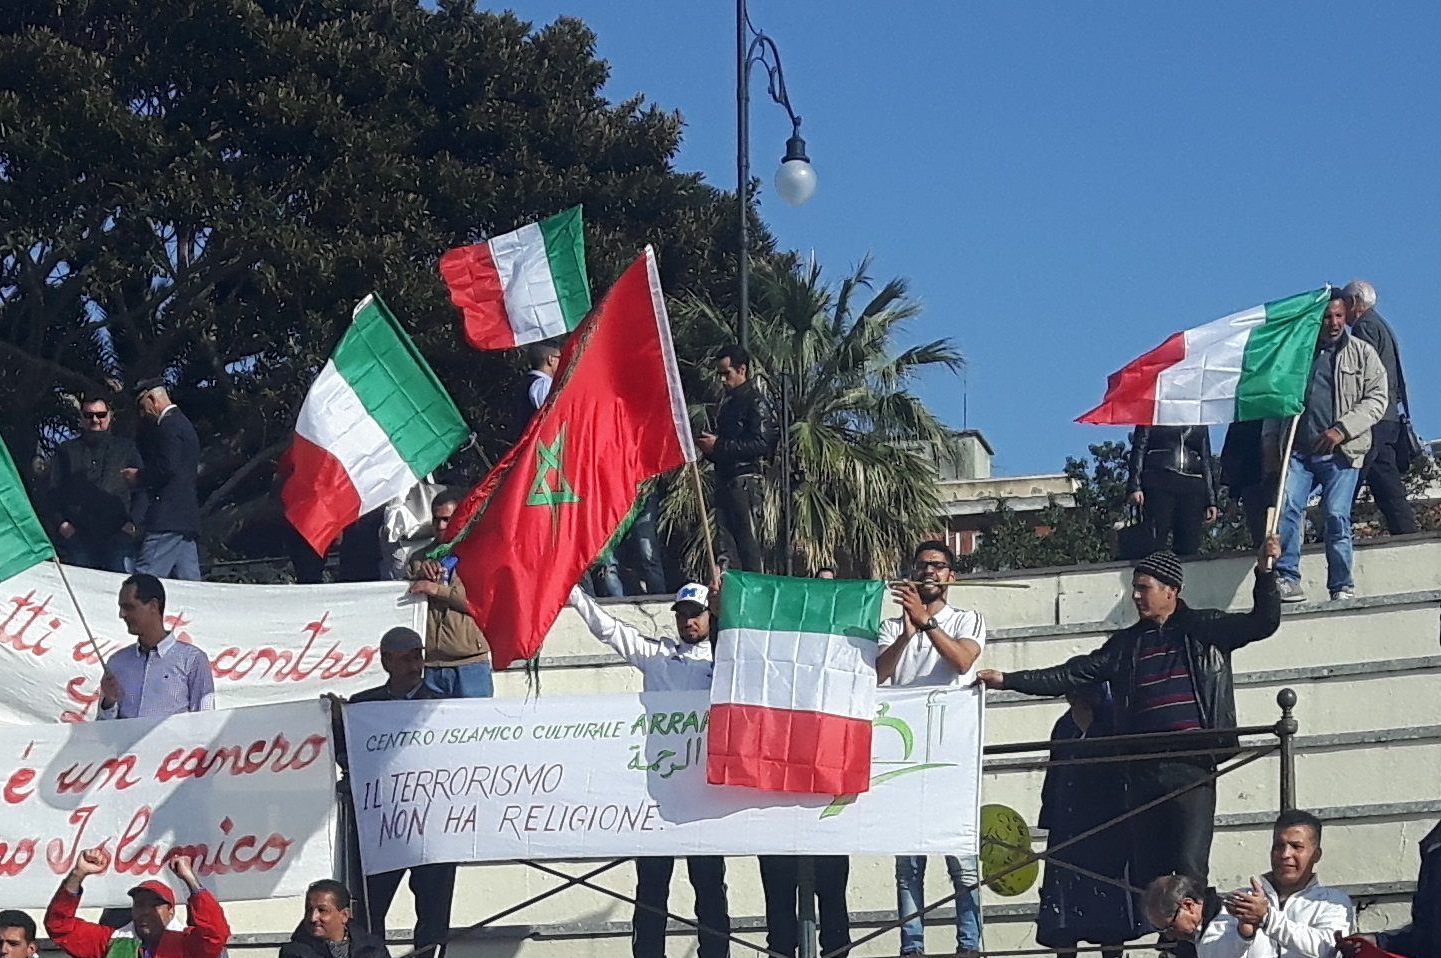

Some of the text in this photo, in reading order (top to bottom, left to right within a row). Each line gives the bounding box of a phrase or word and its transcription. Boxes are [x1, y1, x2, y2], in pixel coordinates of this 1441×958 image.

[210, 610, 379, 682] contro
[365, 728, 436, 752] CENTRO
[439, 725, 524, 745] ISLAMICO
[532, 721, 626, 741] CULTURALE
[627, 736, 702, 779] الرحمة
[56, 754, 142, 794] un
[152, 731, 327, 783] cancro
[363, 763, 564, 811] IL TERRORISMO
[379, 799, 665, 848] NON HA RELIGIONE.
